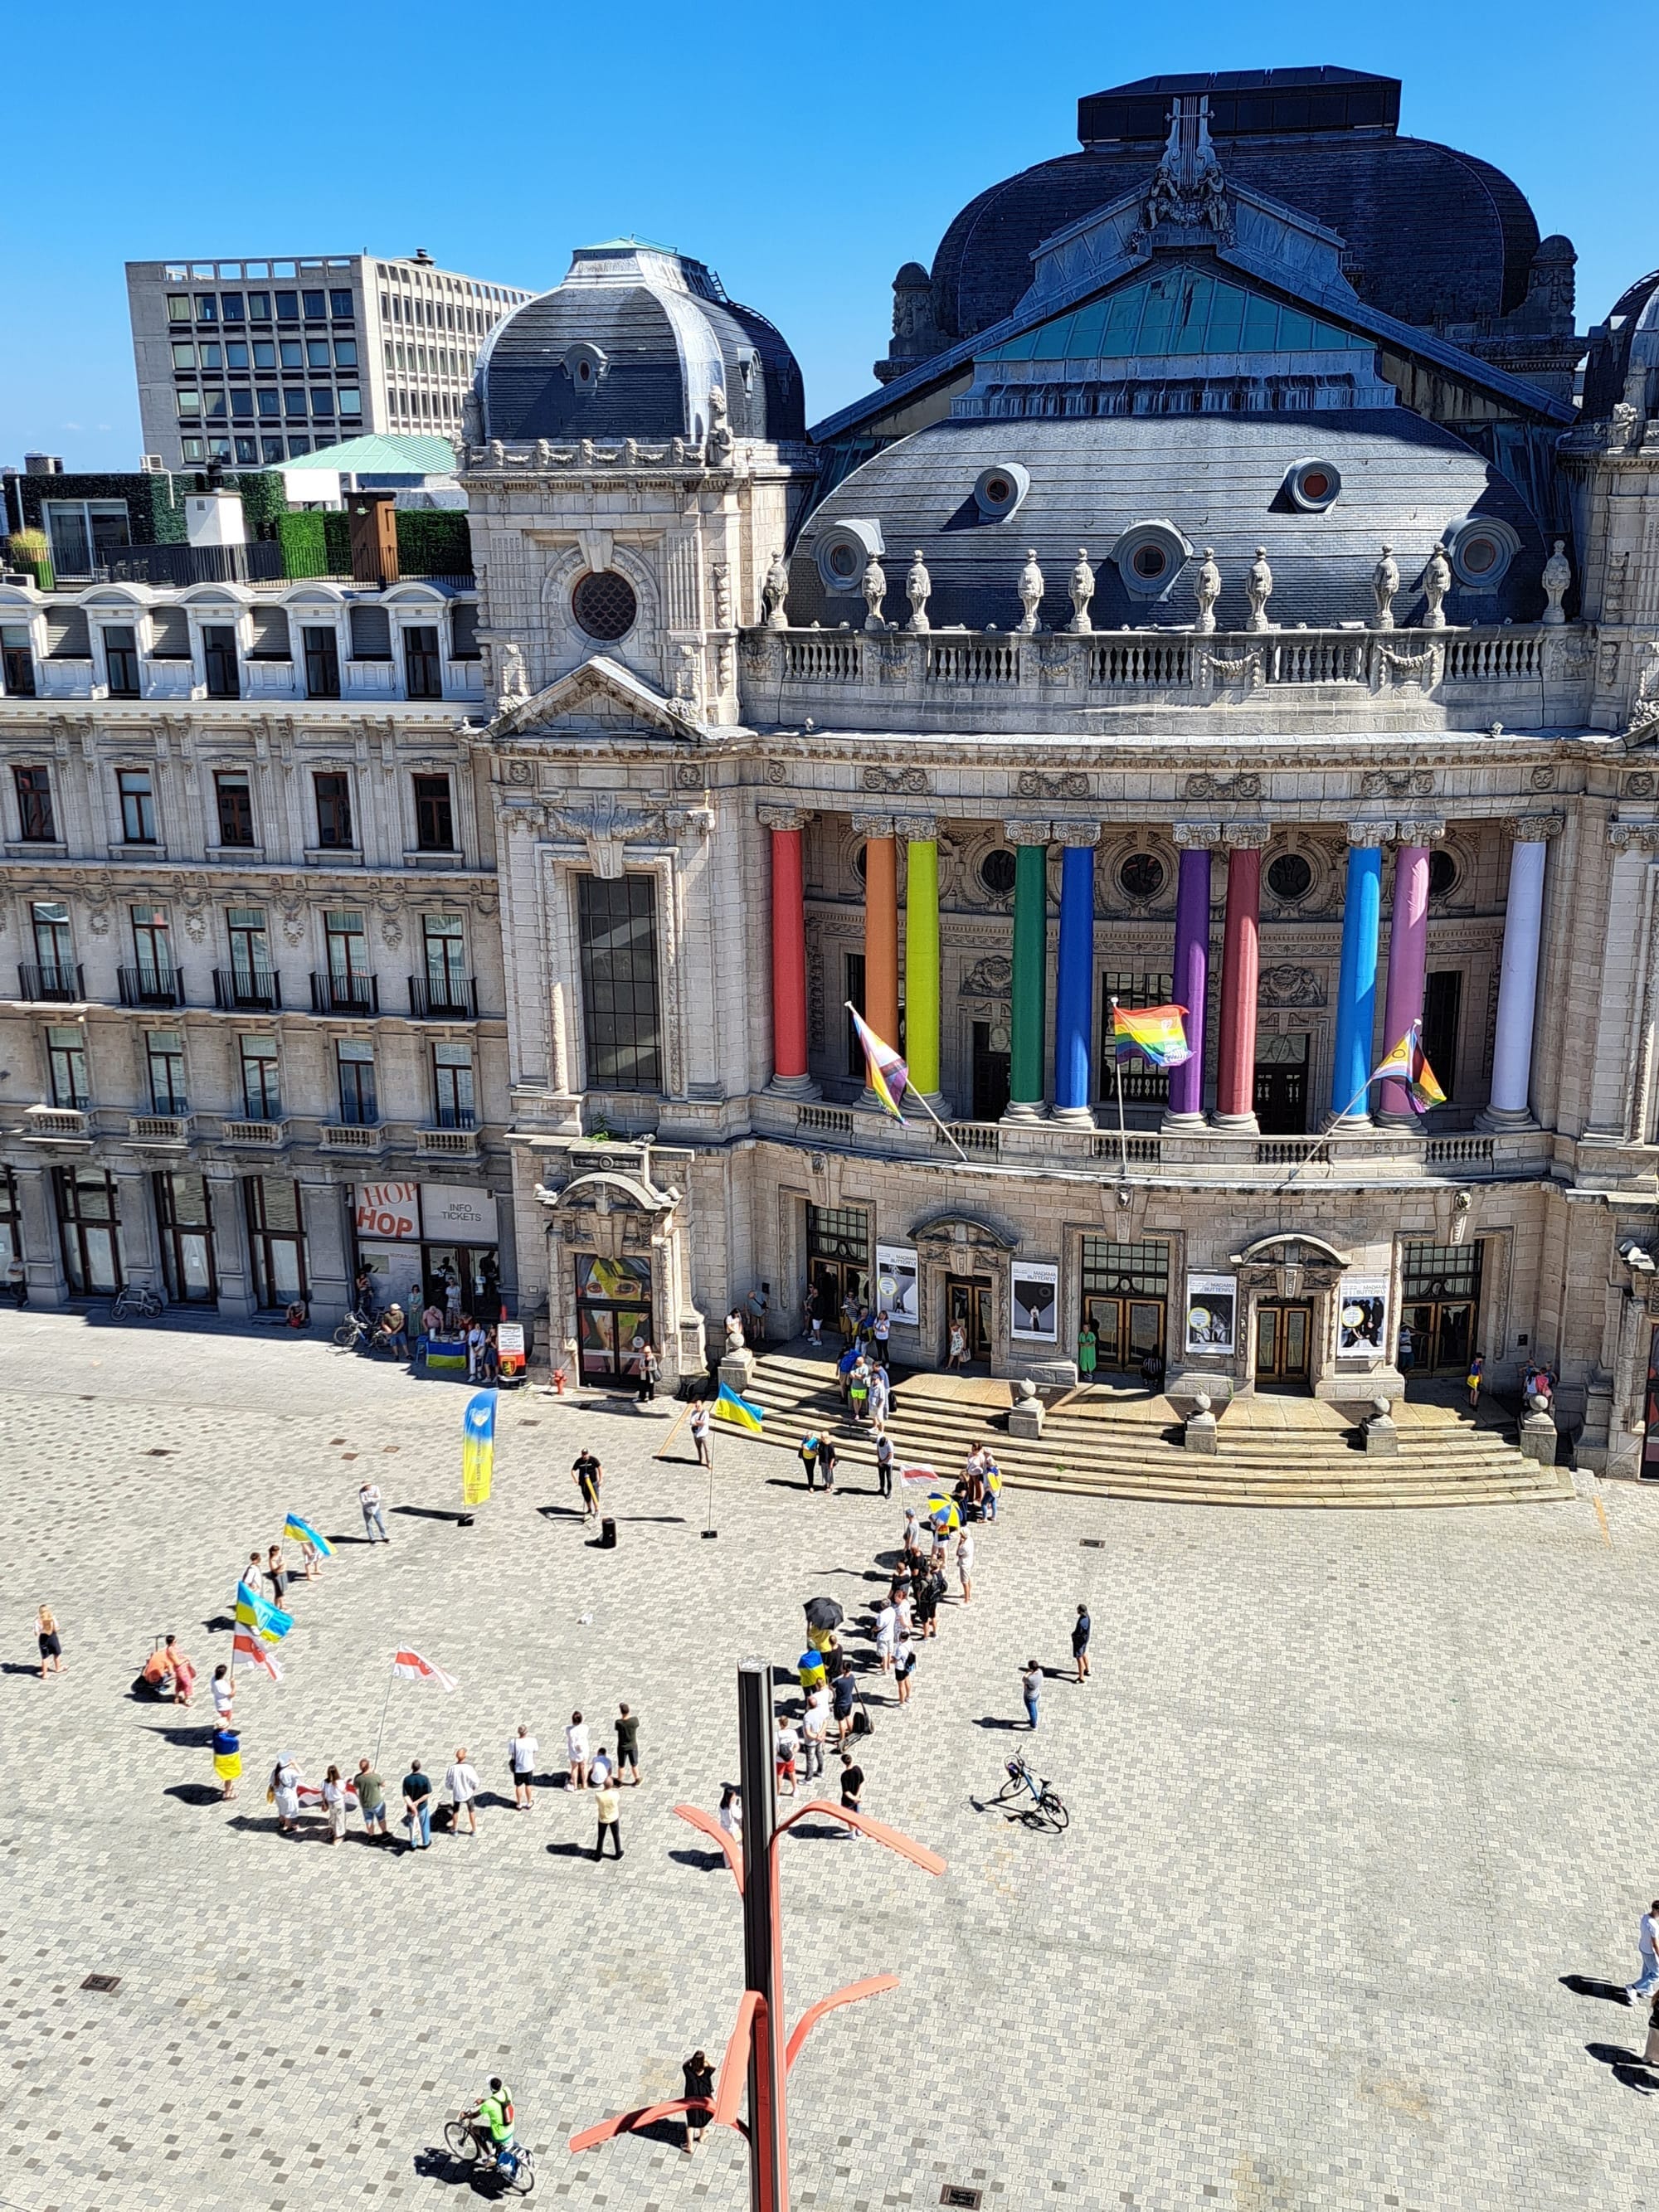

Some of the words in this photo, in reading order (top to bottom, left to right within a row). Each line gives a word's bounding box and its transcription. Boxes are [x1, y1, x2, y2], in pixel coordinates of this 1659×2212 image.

[363, 1182, 418, 1208] HOP
[441, 1211, 482, 1222] TICKETS
[450, 1203, 472, 1212] INFO
[357, 1206, 413, 1238] HOP
